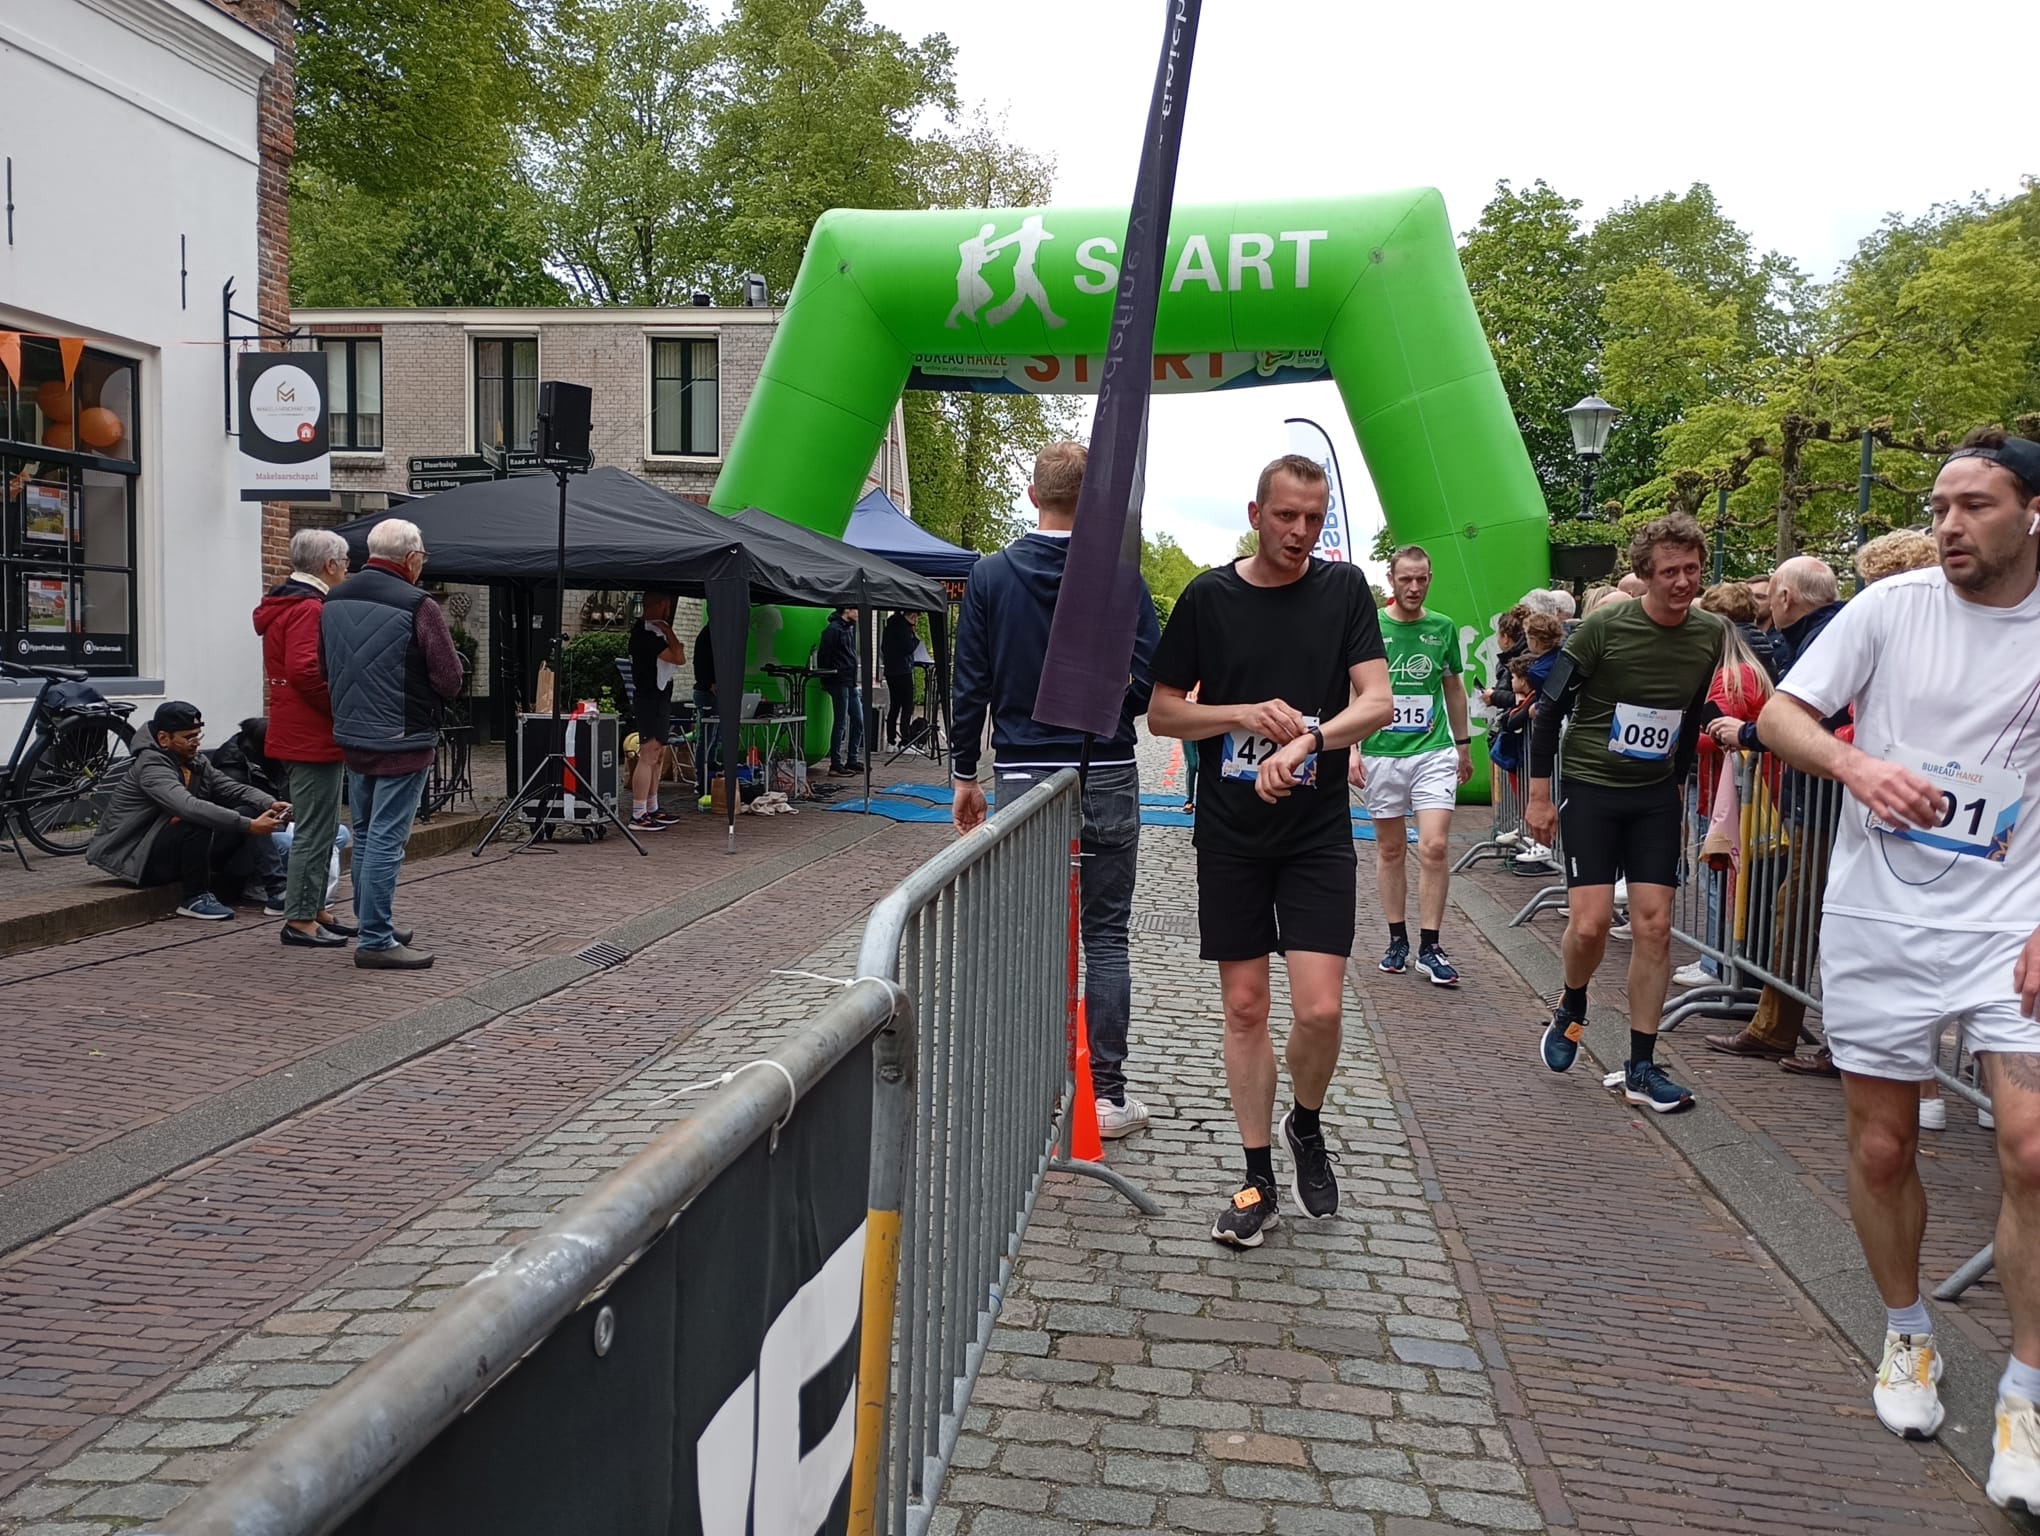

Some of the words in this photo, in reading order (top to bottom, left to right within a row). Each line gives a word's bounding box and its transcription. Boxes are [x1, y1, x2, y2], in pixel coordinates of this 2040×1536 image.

[1073, 230, 1328, 295] SART
[1393, 708, 1425, 724] 315
[1624, 723, 1669, 749] 089
[1922, 761, 1956, 777] BUREAU
[1955, 771, 1985, 784] HANZE
